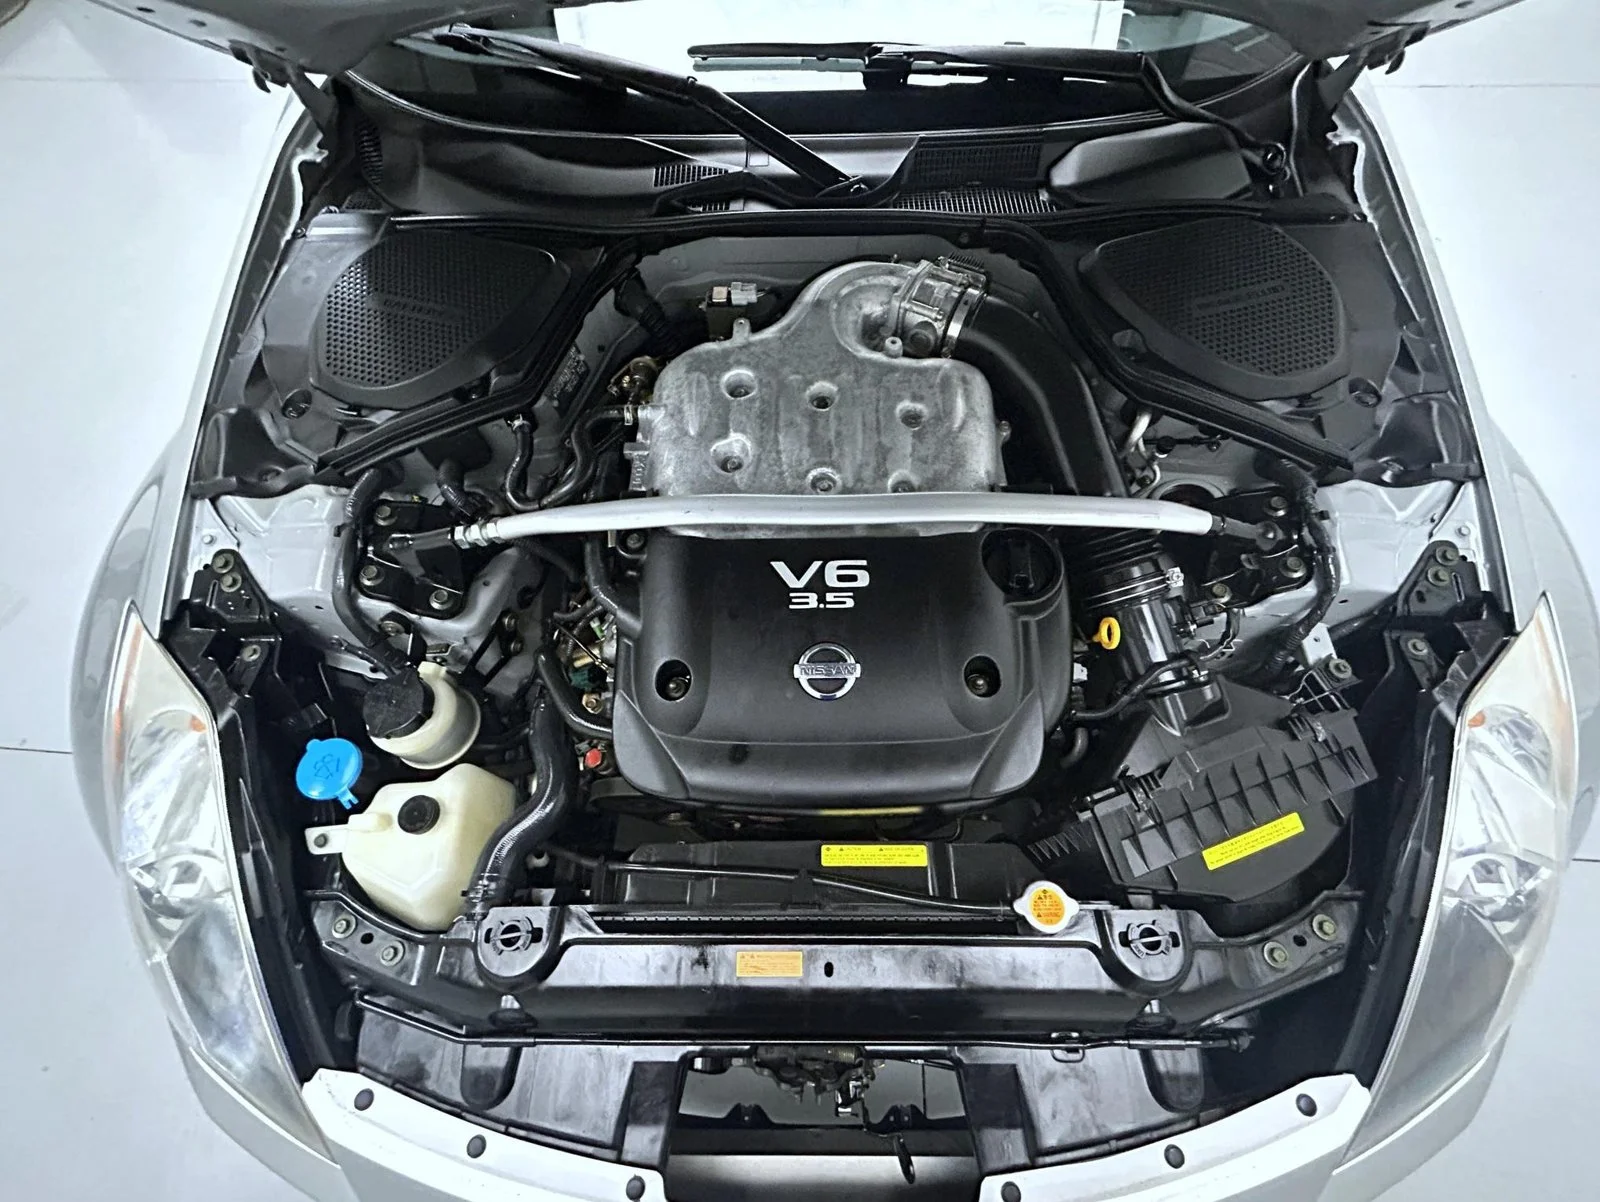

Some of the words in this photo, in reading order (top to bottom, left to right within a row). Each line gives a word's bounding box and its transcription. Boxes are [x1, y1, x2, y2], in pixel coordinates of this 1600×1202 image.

[769, 559, 870, 589] V6
[788, 592, 855, 609] 3.5
[799, 663, 856, 677] NISSAN
